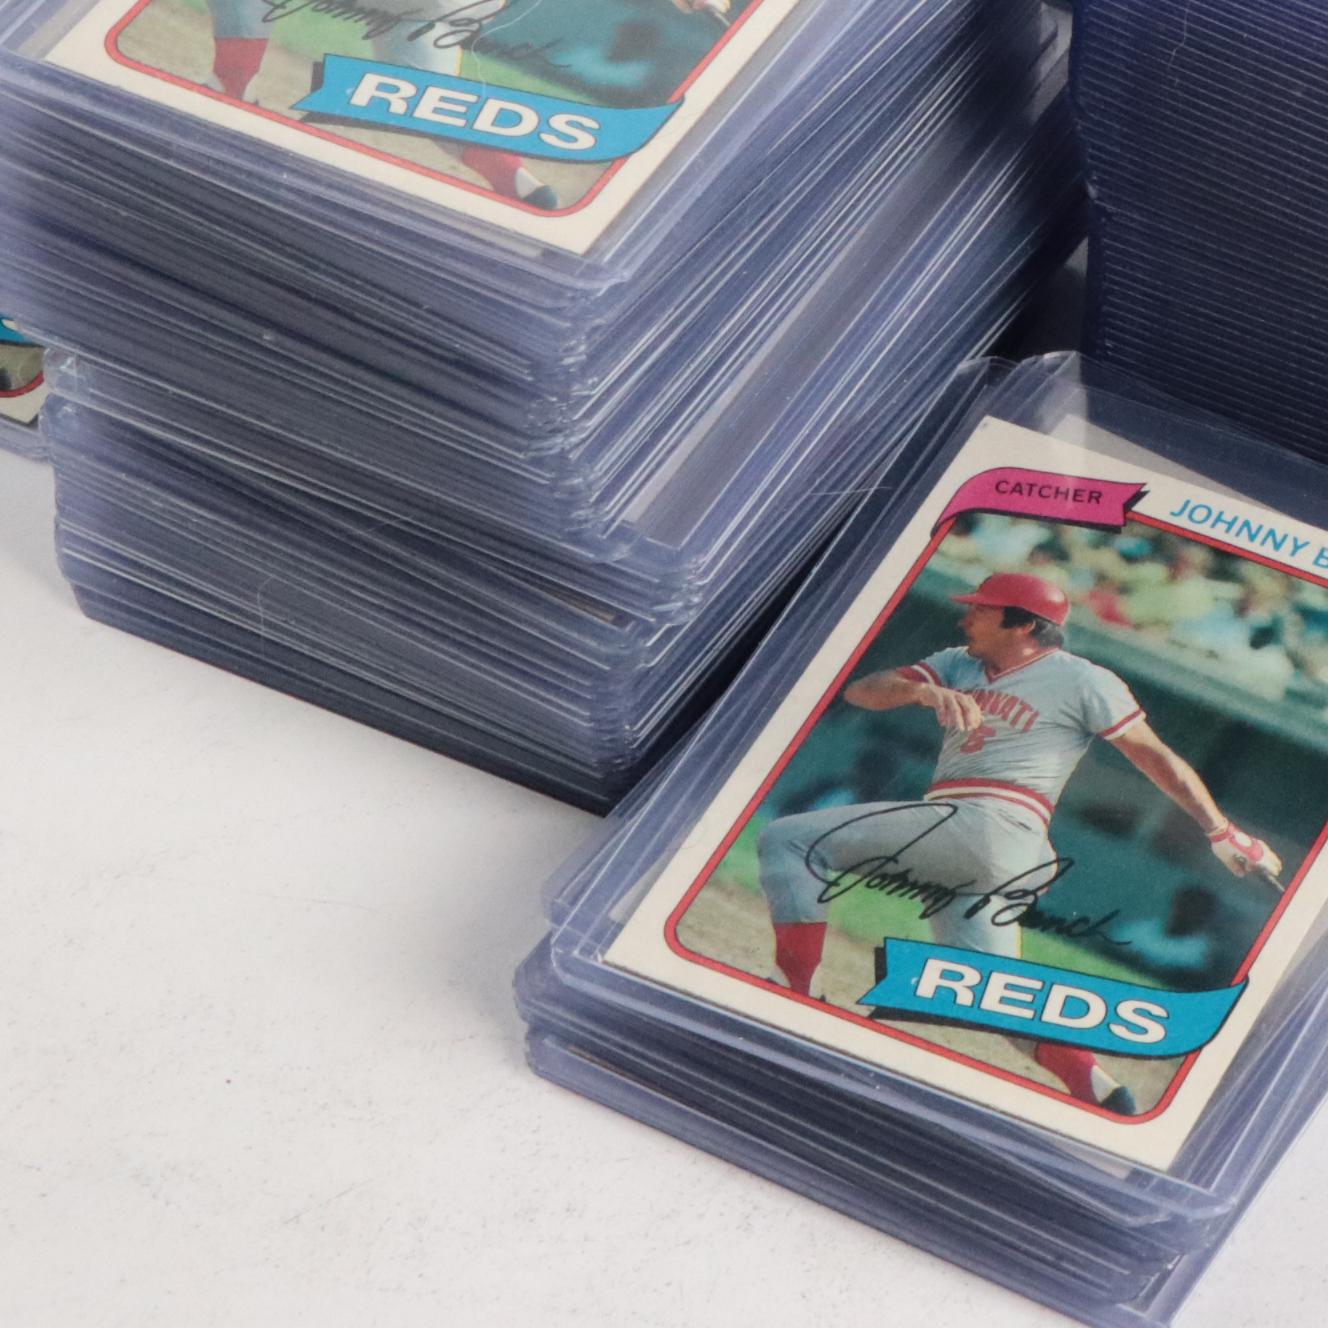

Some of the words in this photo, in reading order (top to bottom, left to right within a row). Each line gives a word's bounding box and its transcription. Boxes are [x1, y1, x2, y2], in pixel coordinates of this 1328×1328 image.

[349, 71, 602, 152] REDS
[994, 479, 1103, 505] CATCHER
[1170, 497, 1311, 559] JOHNNY
[914, 957, 1170, 1044] REDS
